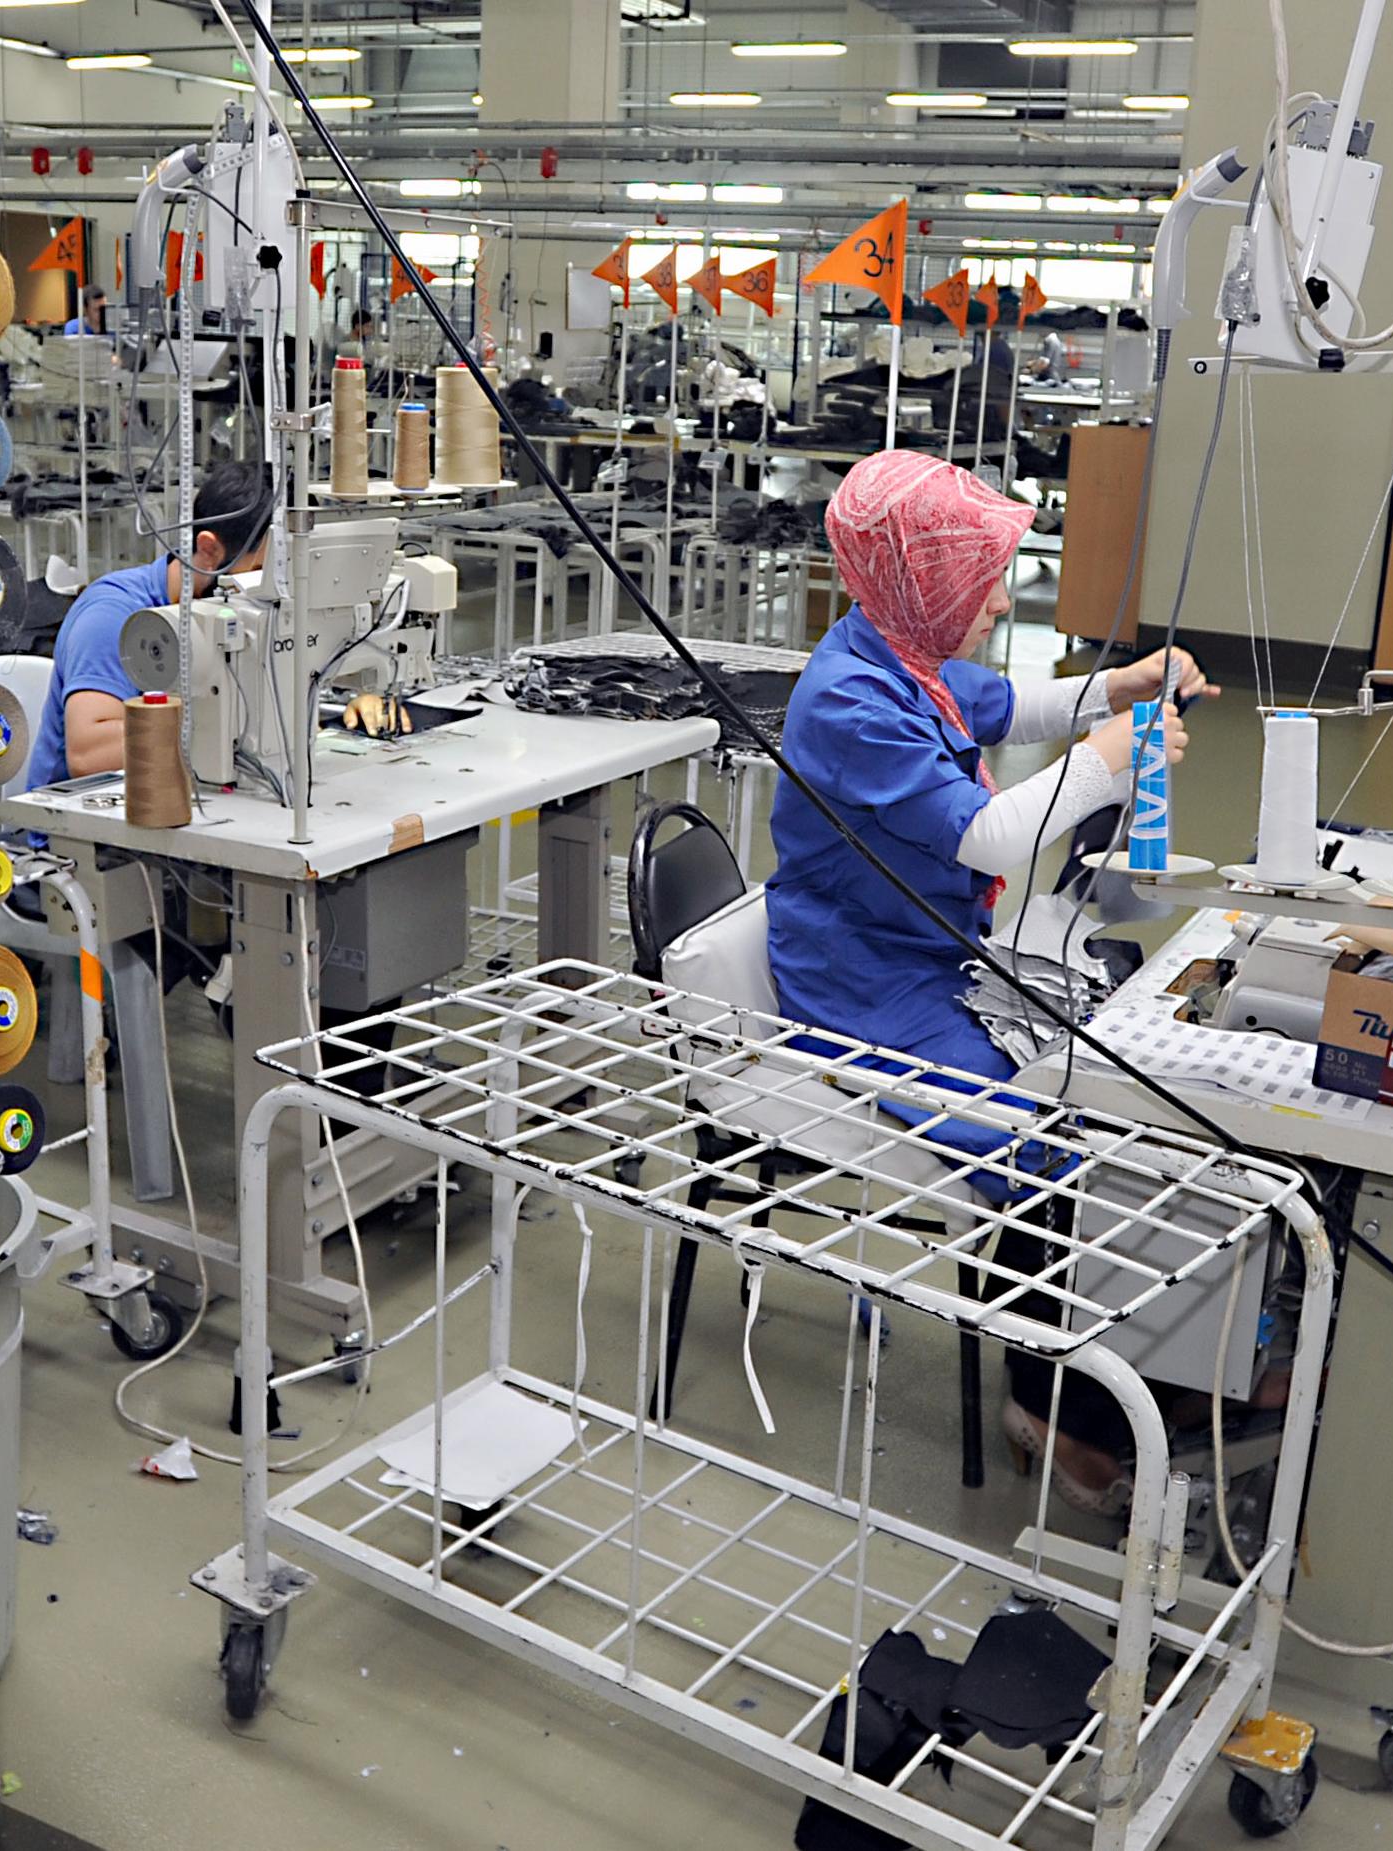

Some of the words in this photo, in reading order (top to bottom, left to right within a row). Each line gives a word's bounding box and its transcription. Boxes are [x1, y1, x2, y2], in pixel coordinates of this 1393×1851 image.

[854, 231, 894, 278] 34
[657, 262, 673, 288] 38
[741, 269, 769, 293] 36
[273, 633, 320, 653] broer
